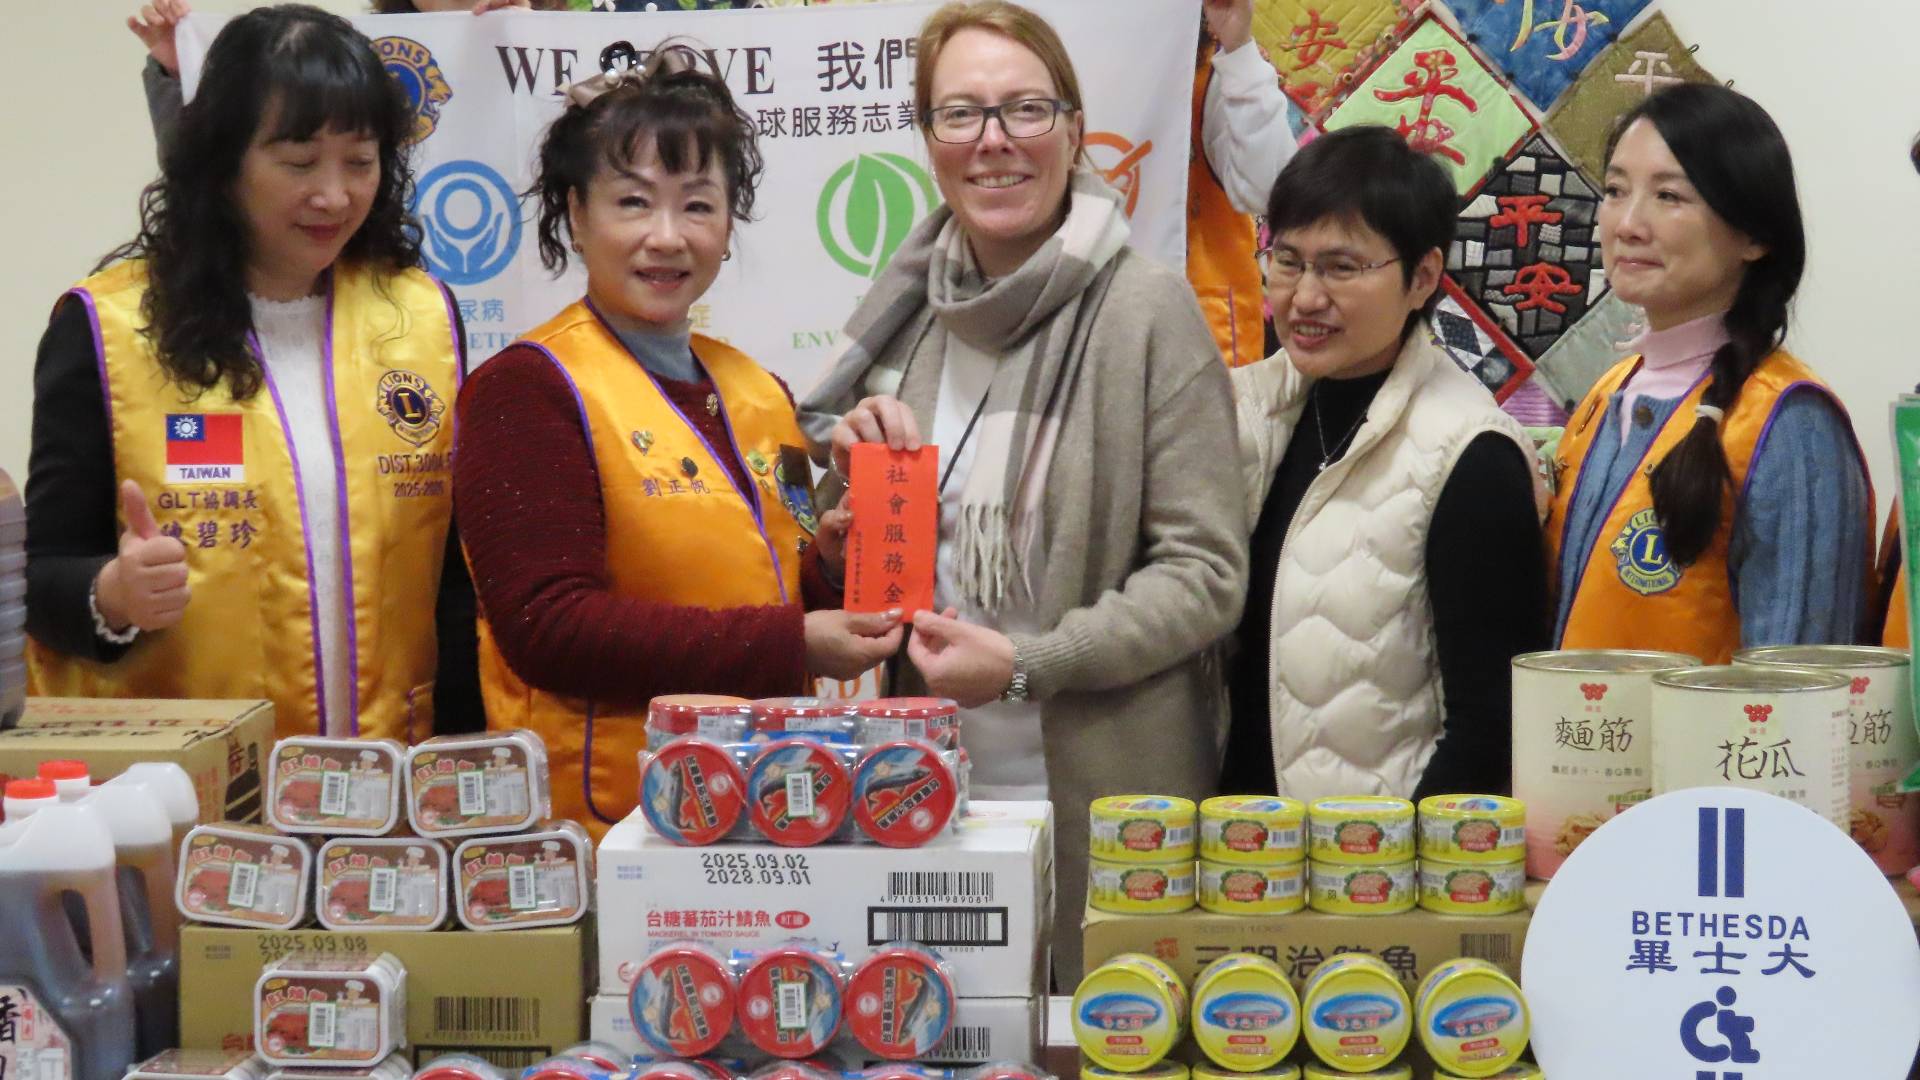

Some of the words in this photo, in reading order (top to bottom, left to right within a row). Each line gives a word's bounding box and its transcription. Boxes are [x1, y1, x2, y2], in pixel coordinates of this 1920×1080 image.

[495, 46, 578, 96] WE
[1489, 194, 1584, 313] 平安
[179, 467, 231, 479] TAIWAN
[882, 464, 908, 603] 社會服務金
[1715, 736, 1806, 781] 花瓜
[701, 853, 810, 869] 2025.09.02
[704, 868, 812, 885] 2028.09.01
[257, 935, 368, 951] 2025.09.08
[1632, 910, 1811, 941] BETHESDA
[1625, 938, 1817, 979] 畢士大
